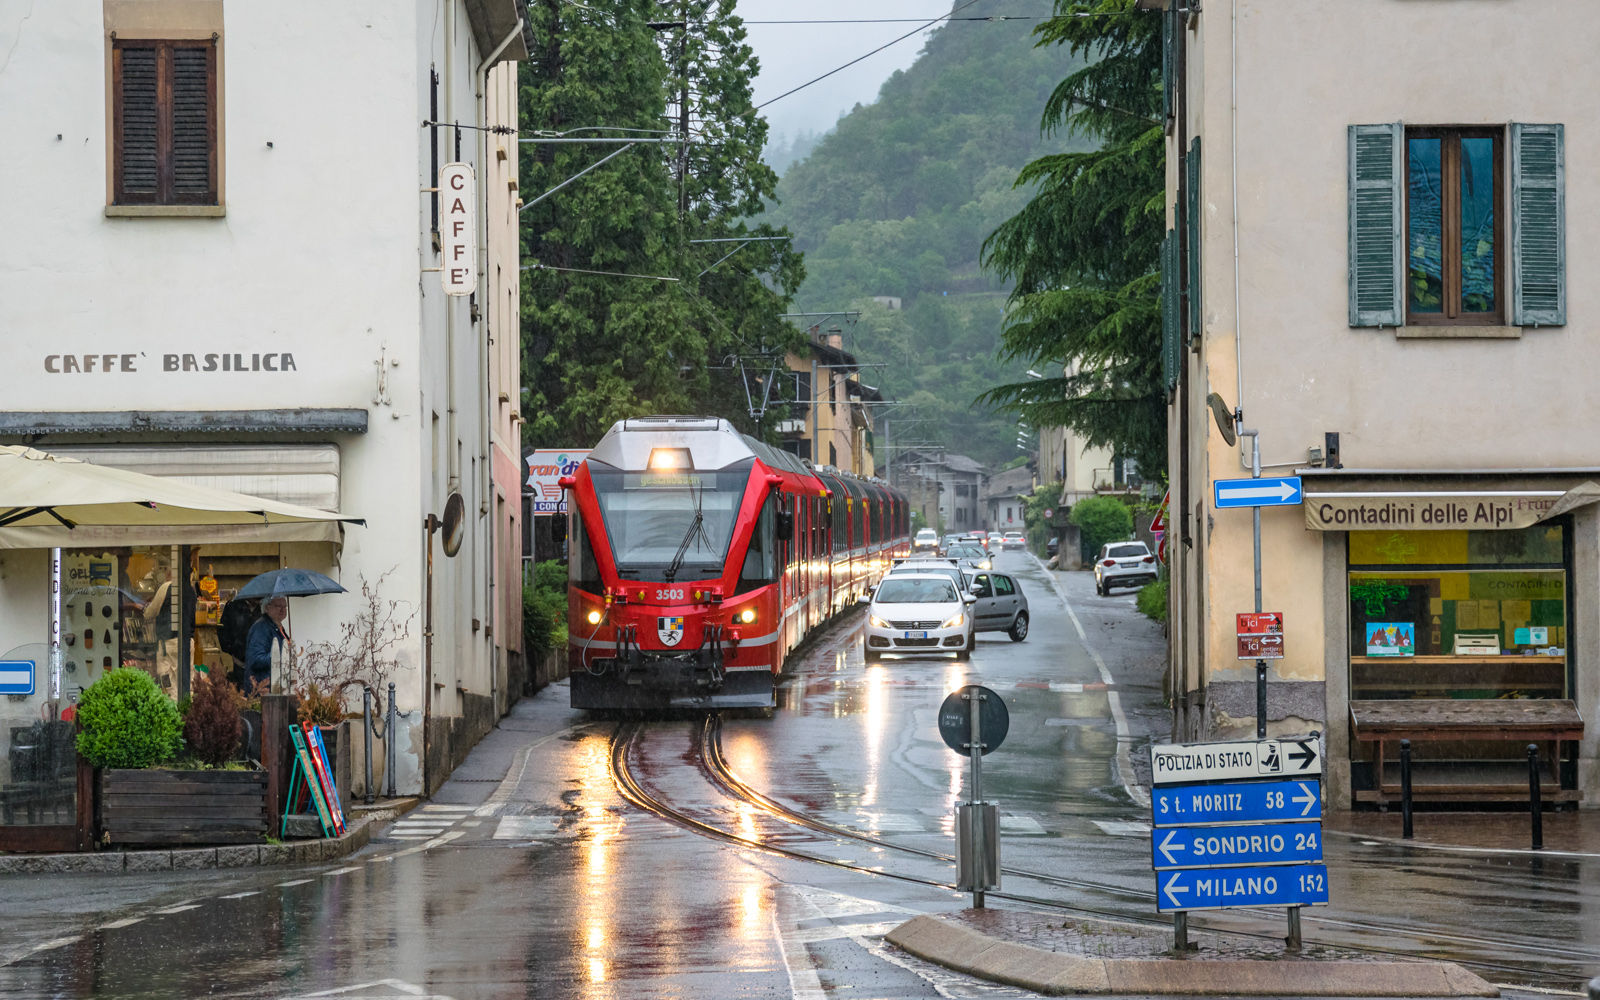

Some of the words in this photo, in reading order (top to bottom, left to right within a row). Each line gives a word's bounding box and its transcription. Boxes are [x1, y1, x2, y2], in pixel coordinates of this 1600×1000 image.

[163, 353, 297, 372] BASILICA
[529, 465, 560, 476] ran
[1319, 503, 1415, 524] Contadini
[1421, 502, 1468, 523] delle
[1474, 502, 1513, 527] Alpi
[1488, 580, 1551, 589] CONTADINI
[655, 589, 684, 600] 3503
[1240, 618, 1258, 627] bici
[1241, 641, 1259, 651] bici
[1158, 754, 1203, 772] POLIZIA
[1205, 753, 1216, 769] DI
[1219, 751, 1252, 768] STATO
[1192, 793, 1243, 813] MORITZ
[1265, 791, 1285, 809] 58
[1193, 834, 1285, 856] SONDRIO
[1294, 832, 1318, 851] 24
[1196, 876, 1278, 897] MILANO
[1299, 874, 1324, 893] 152
